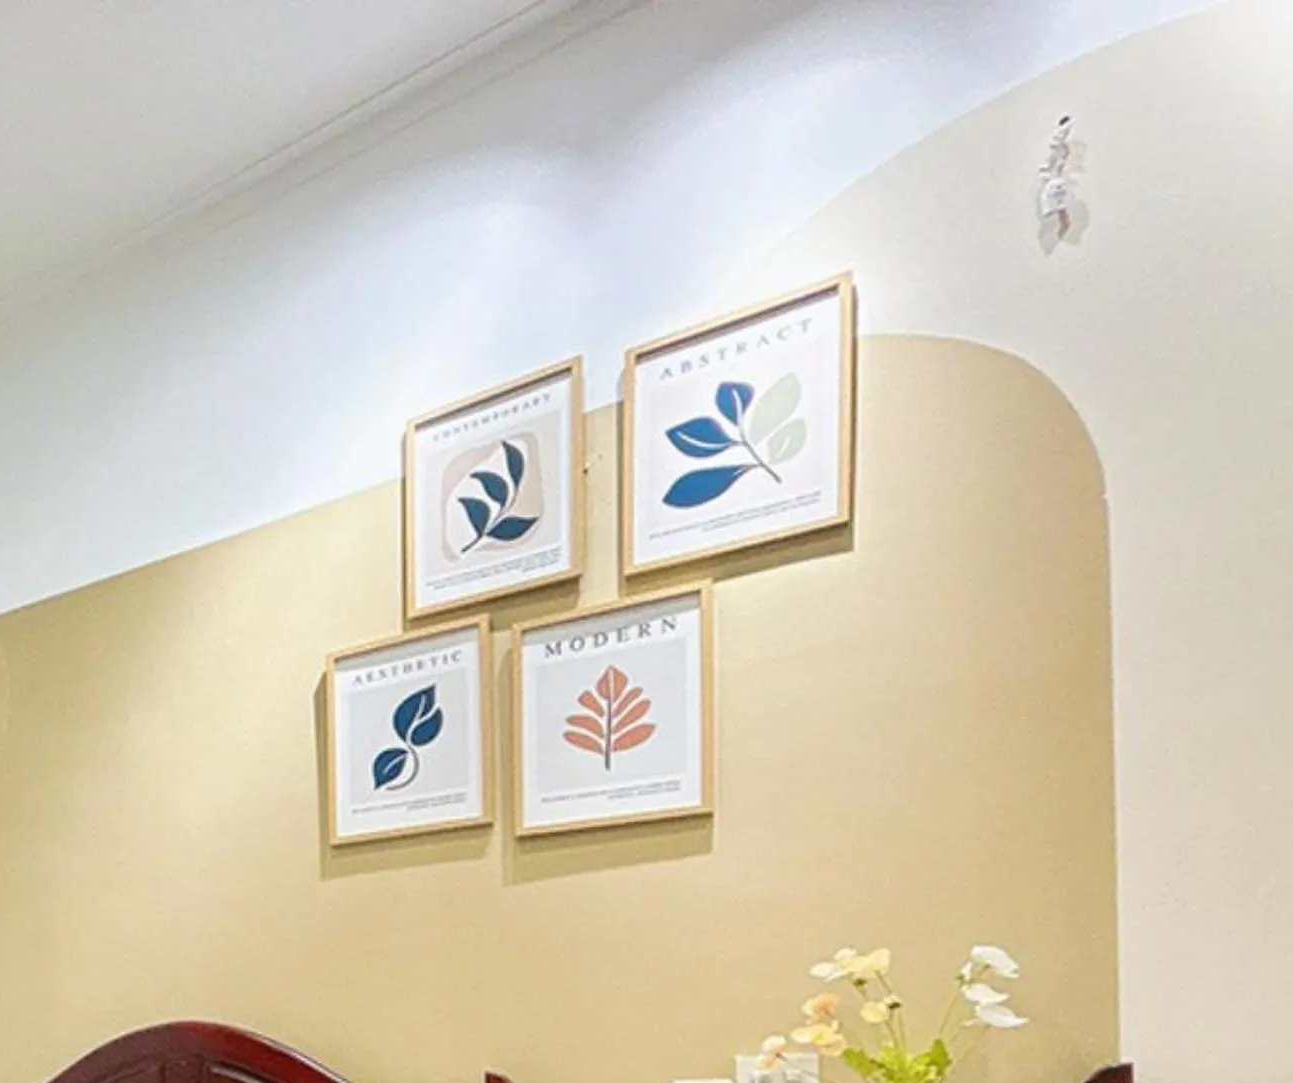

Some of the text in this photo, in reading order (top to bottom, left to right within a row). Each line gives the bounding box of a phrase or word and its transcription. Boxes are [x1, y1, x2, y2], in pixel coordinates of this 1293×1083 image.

[659, 317, 813, 381] ABSTRACT
[543, 616, 677, 658] MODERN
[351, 649, 463, 685] AESTHETIC
